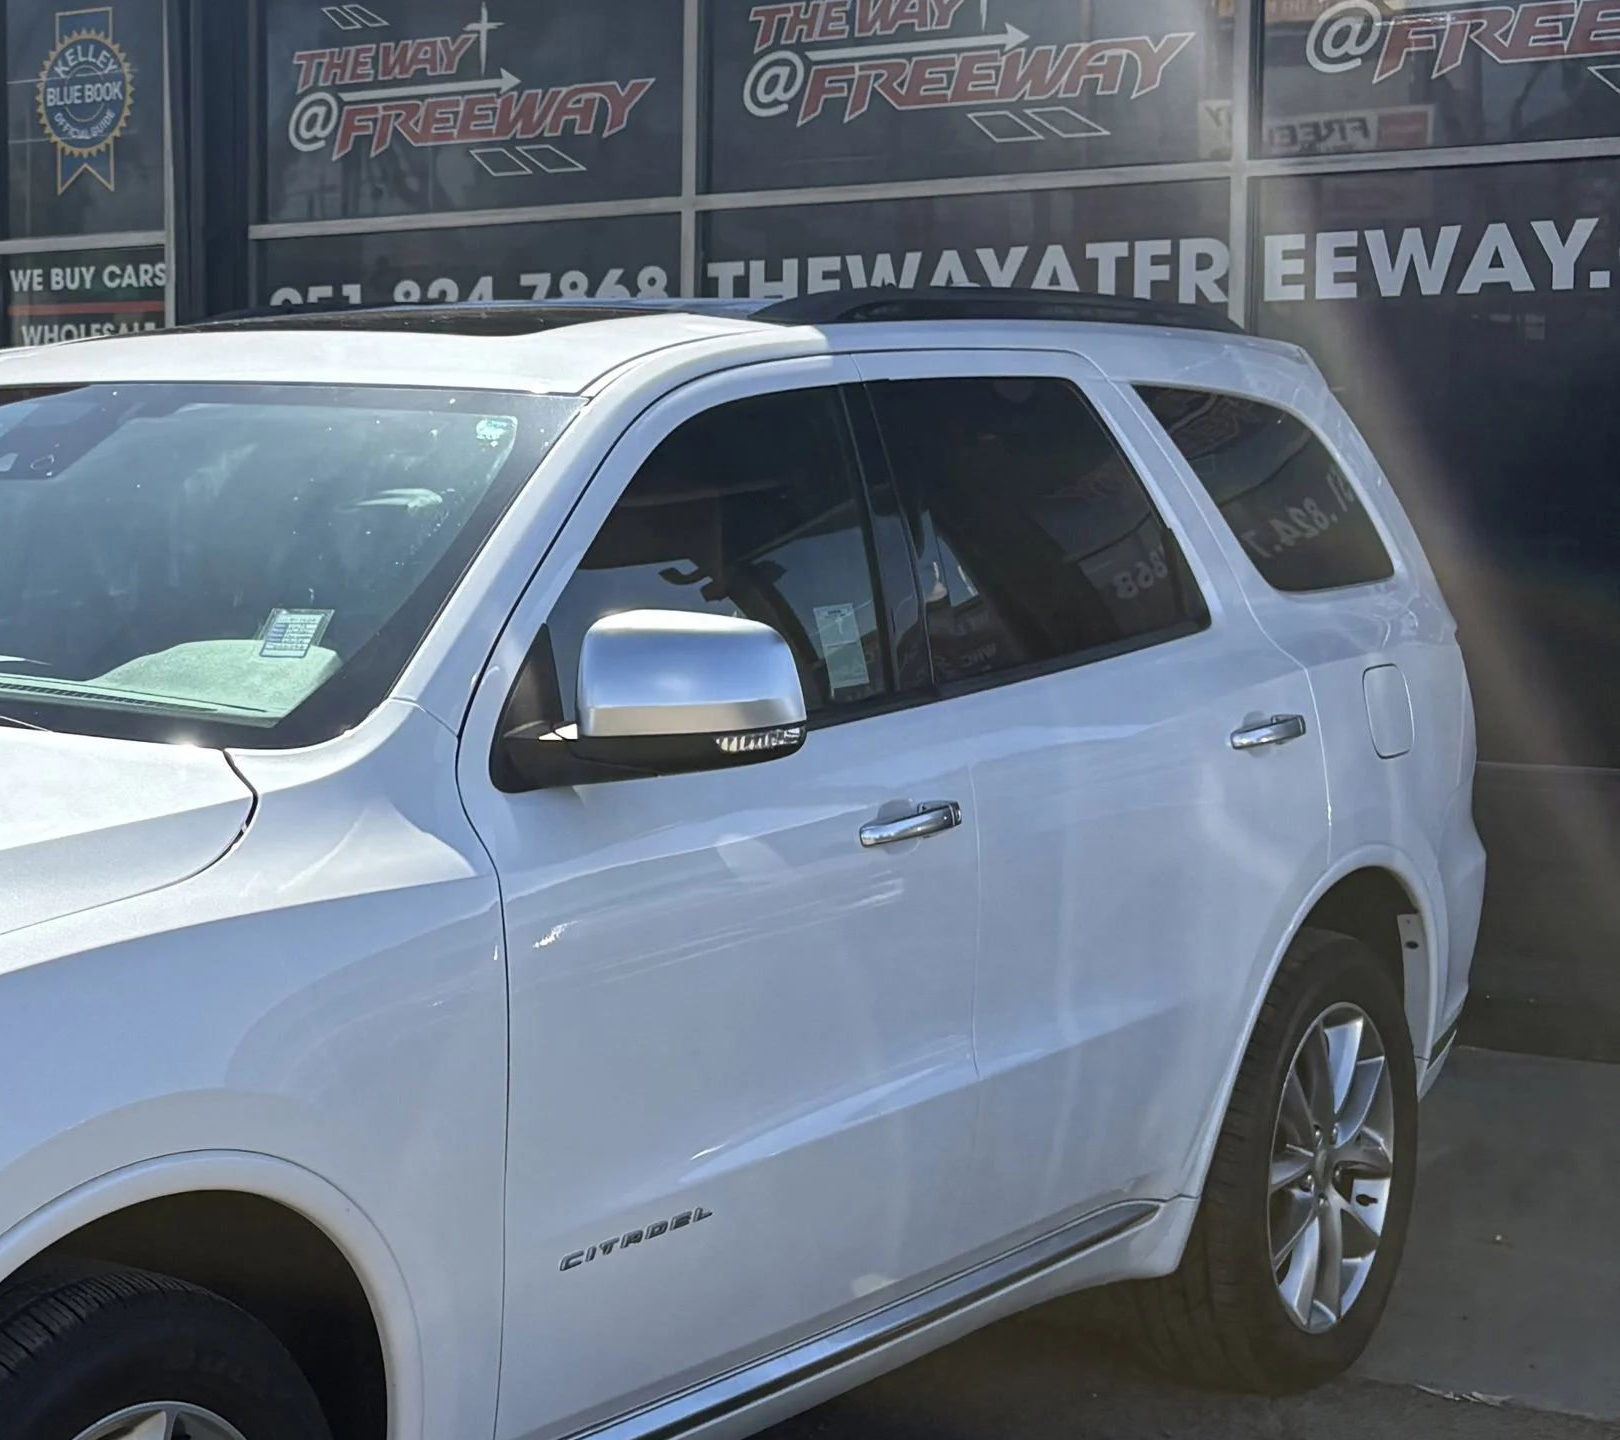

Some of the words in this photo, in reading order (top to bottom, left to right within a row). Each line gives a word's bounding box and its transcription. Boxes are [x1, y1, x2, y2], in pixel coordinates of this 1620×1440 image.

[54, 43, 119, 78] KELLEY
[293, 43, 376, 94] THE
[377, 33, 479, 80] WAY
[46, 86, 82, 107] BLUE
[84, 81, 123, 104] BOOK
[54, 112, 91, 139] OFFICIAL
[91, 109, 116, 137] GUIDE
[9, 269, 44, 293] WE
[50, 266, 96, 291] BUY
[102, 262, 167, 289] CARS
[559, 1206, 713, 1272] CITADEL
